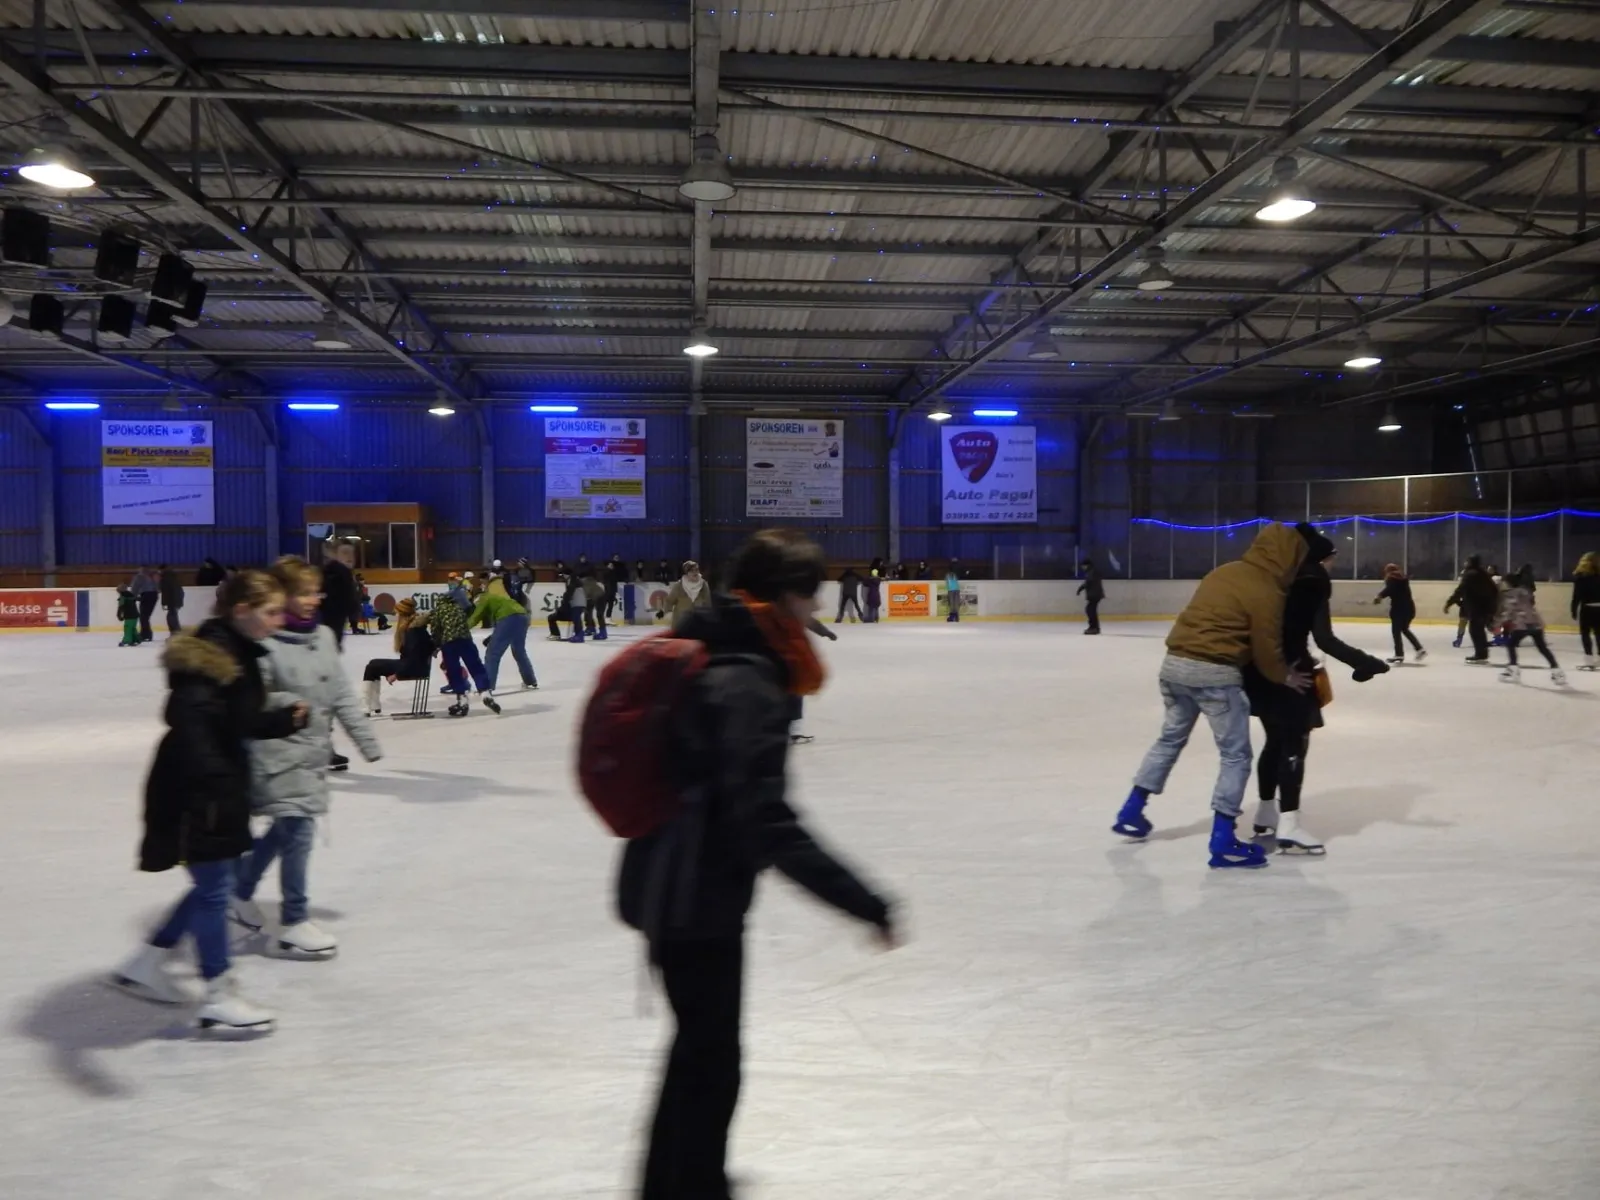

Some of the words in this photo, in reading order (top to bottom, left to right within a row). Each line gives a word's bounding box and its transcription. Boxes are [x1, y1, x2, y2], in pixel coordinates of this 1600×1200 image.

[108, 425, 169, 436] SPONSOREN
[549, 420, 606, 432] SPONSOREN
[750, 422, 804, 434] SPONSOREN
[956, 439, 992, 447] Auto
[944, 489, 984, 500] Auto
[1, 602, 41, 614] kasse
